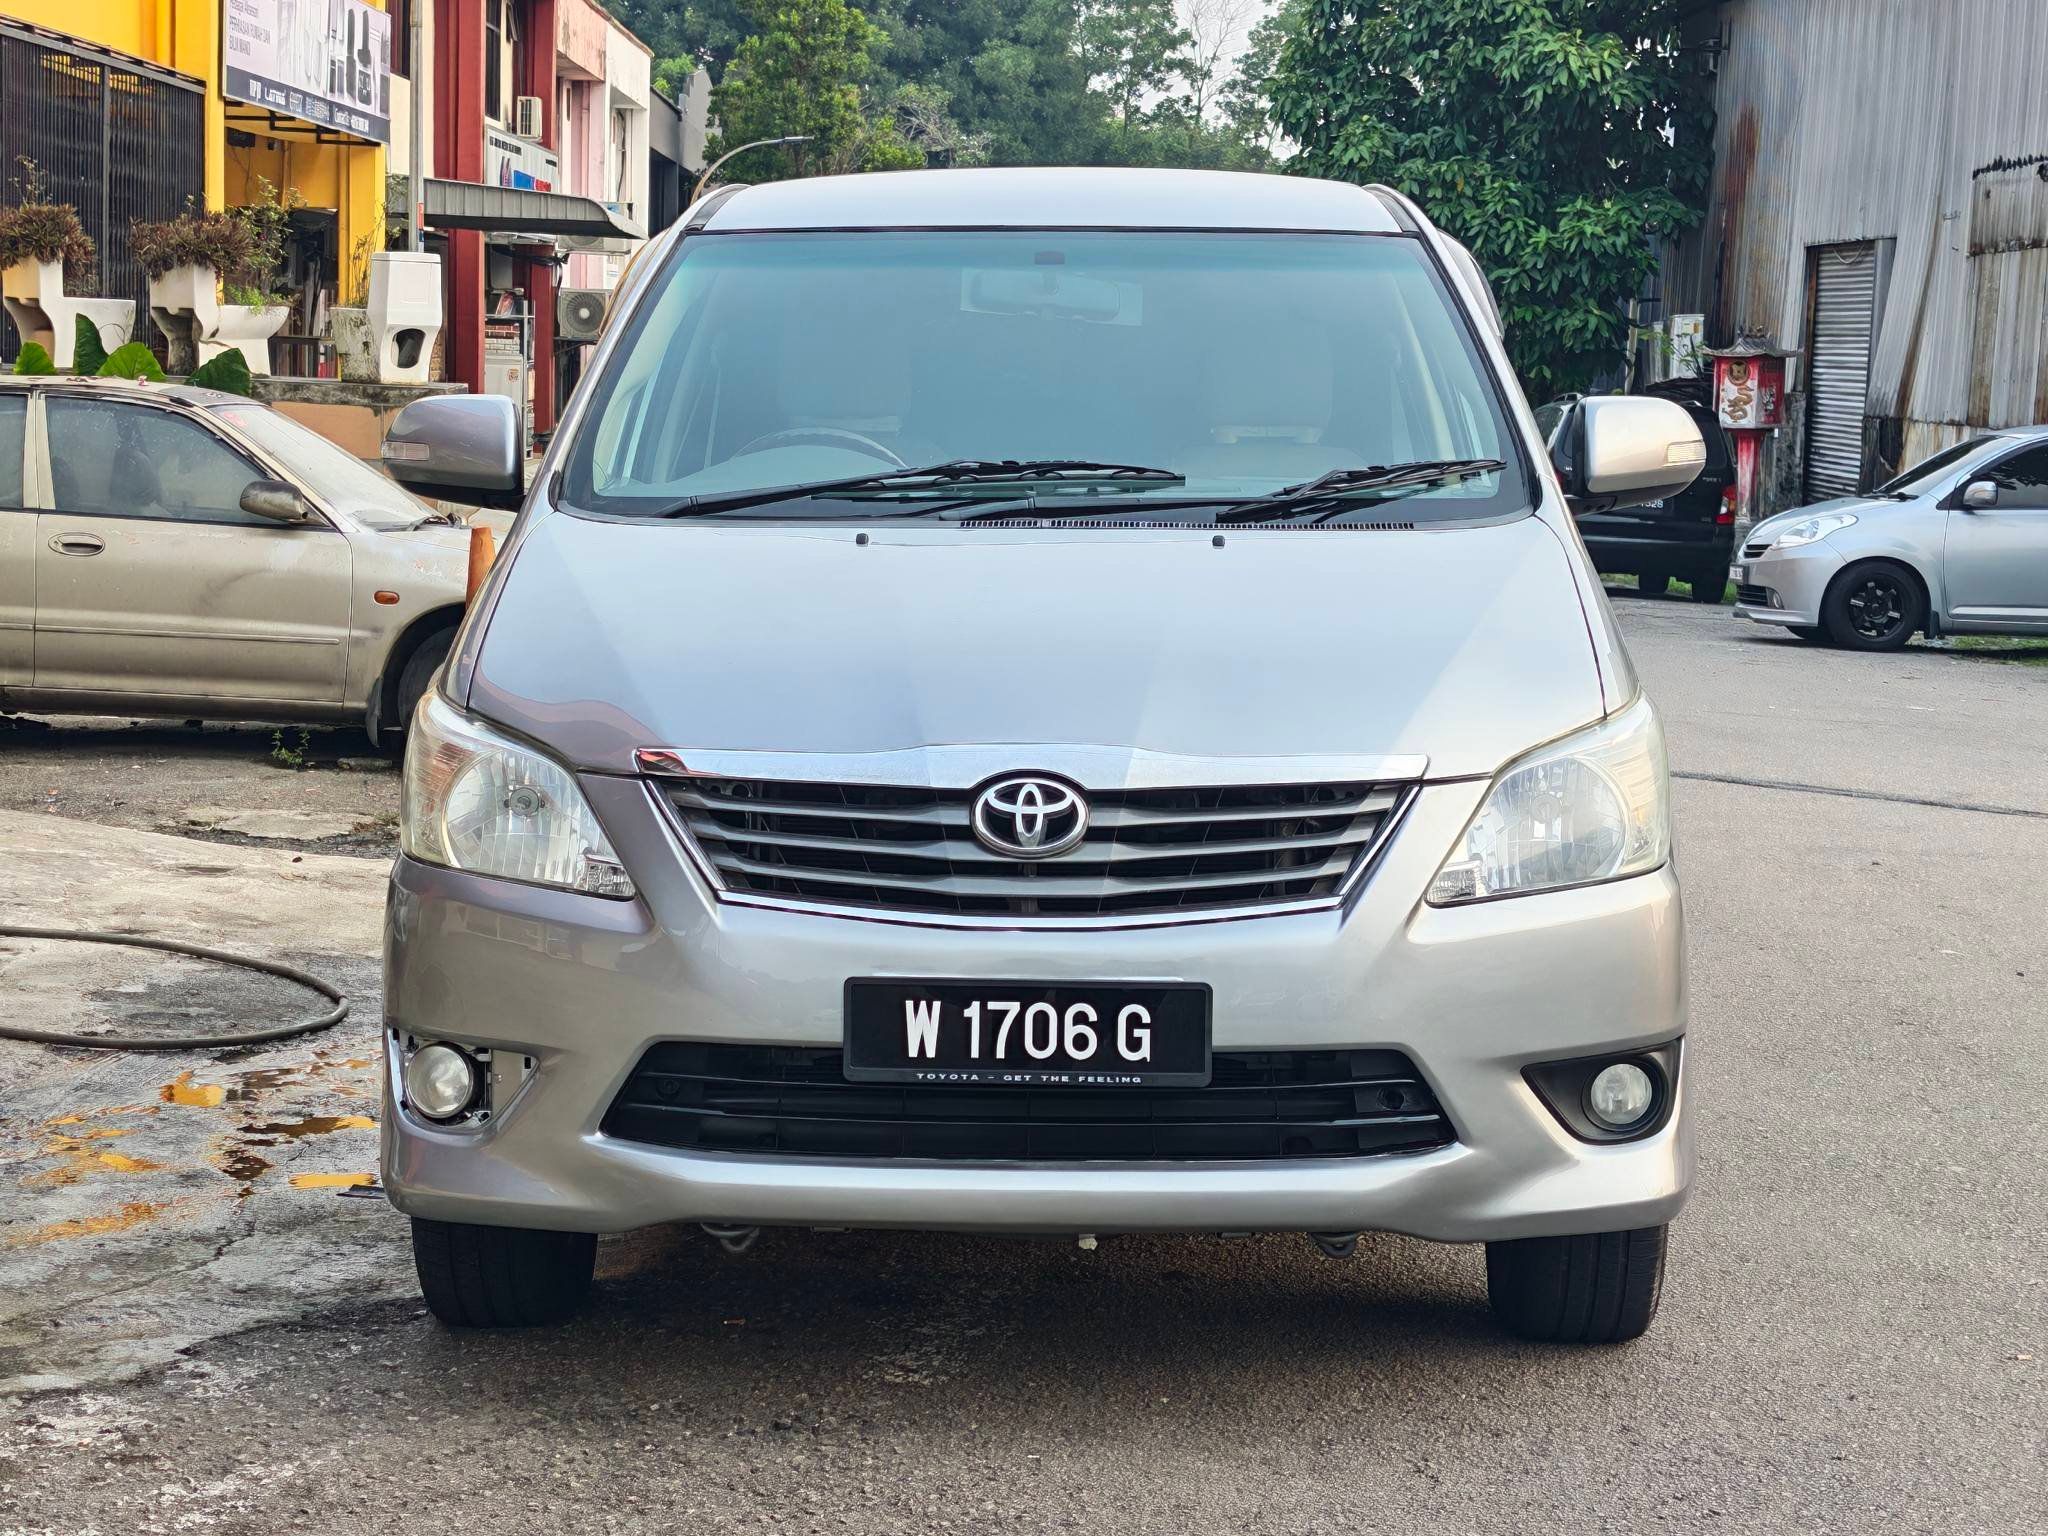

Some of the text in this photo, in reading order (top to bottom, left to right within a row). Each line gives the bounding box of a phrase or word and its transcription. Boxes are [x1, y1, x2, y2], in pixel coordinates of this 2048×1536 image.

[905, 1000, 1151, 1062] W 1706 G
[916, 1073, 980, 1081] TOYOTA
[1003, 1074, 1032, 1082] GET
[1041, 1075, 1070, 1083] THE
[1078, 1075, 1142, 1084] FEELING
